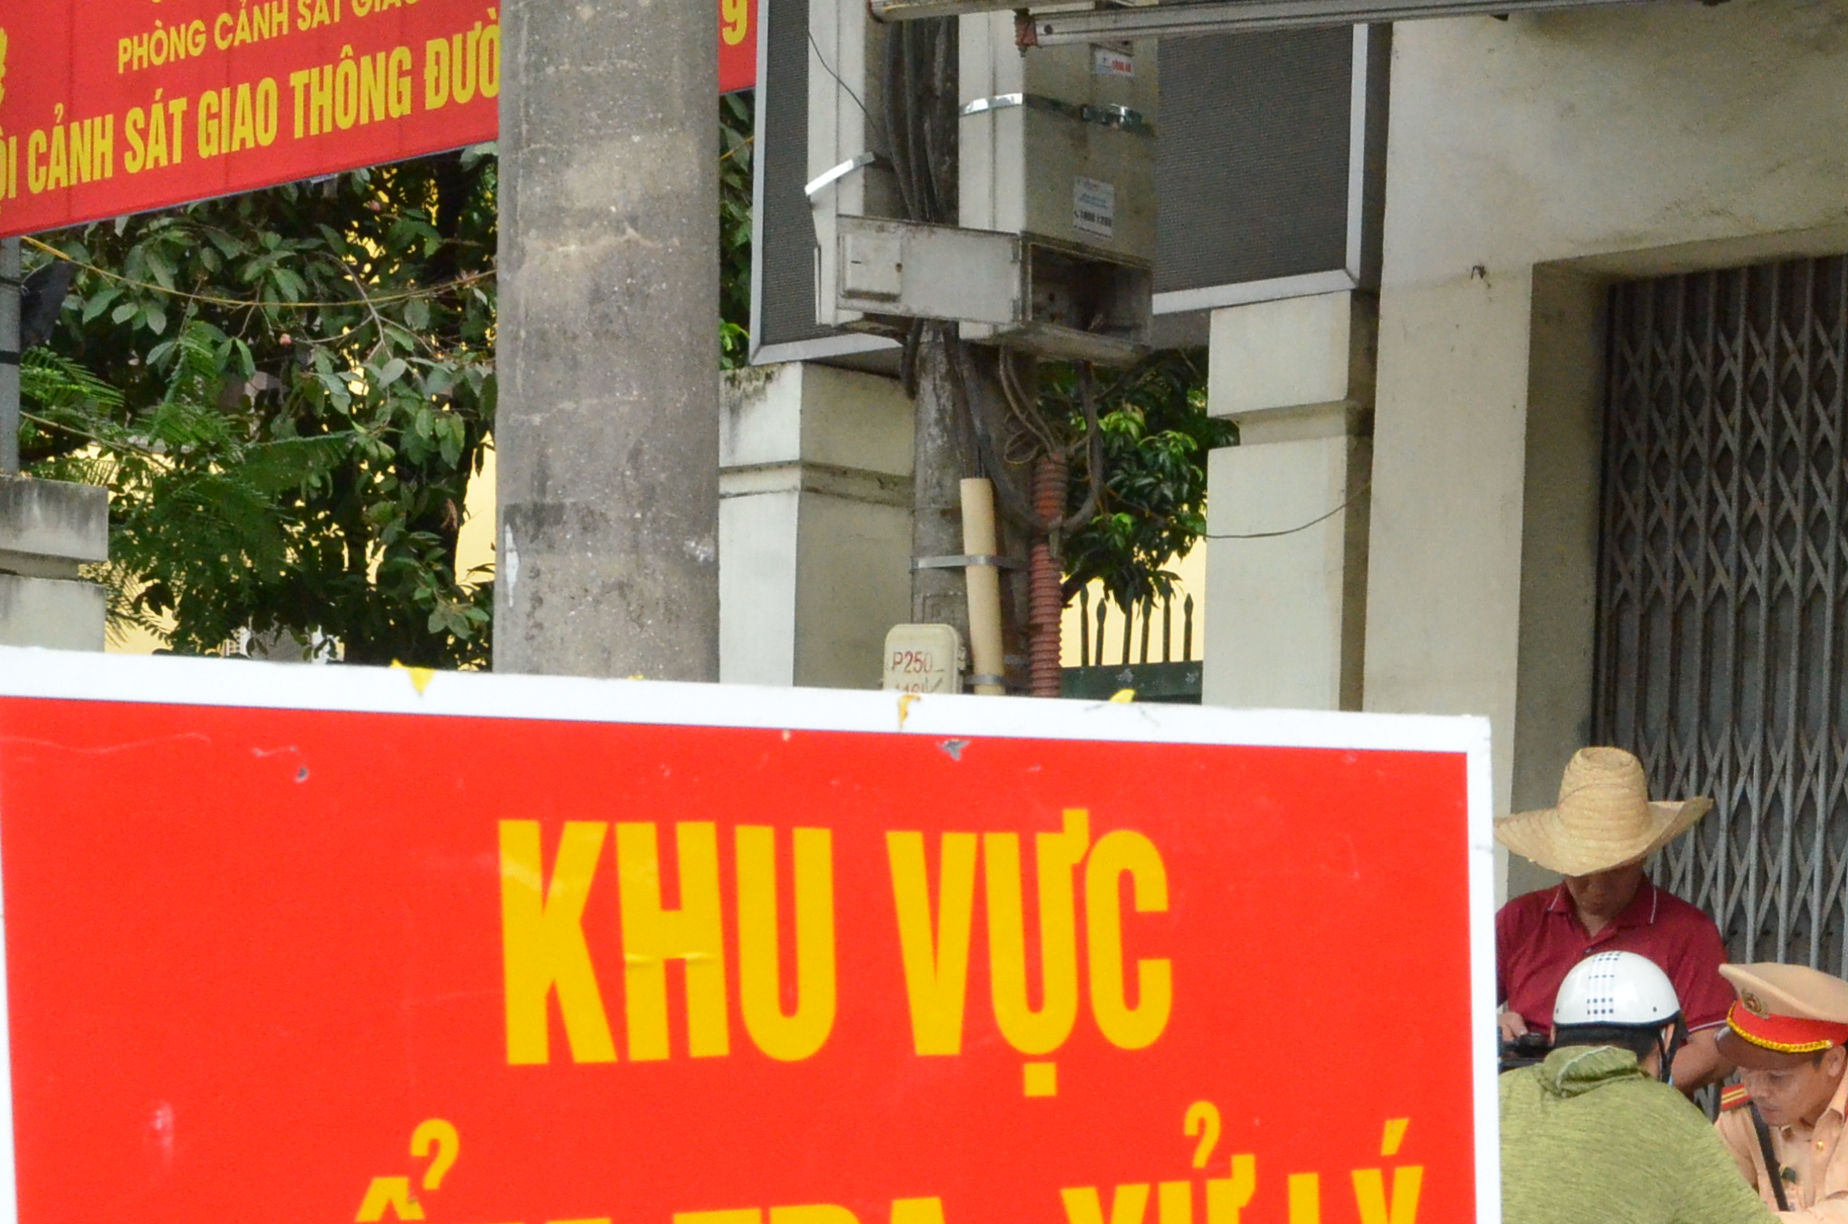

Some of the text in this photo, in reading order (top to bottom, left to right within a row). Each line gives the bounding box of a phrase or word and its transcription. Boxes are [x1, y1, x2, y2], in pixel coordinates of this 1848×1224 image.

[117, 19, 207, 74] PHÒNG
[214, 0, 289, 50] CẢNH
[27, 103, 114, 194] CẢNH
[124, 88, 187, 174] SÁT
[197, 77, 278, 159] GIAO
[290, 44, 412, 139] THÔNG
[498, 808, 1173, 1097] KHU VỰC
